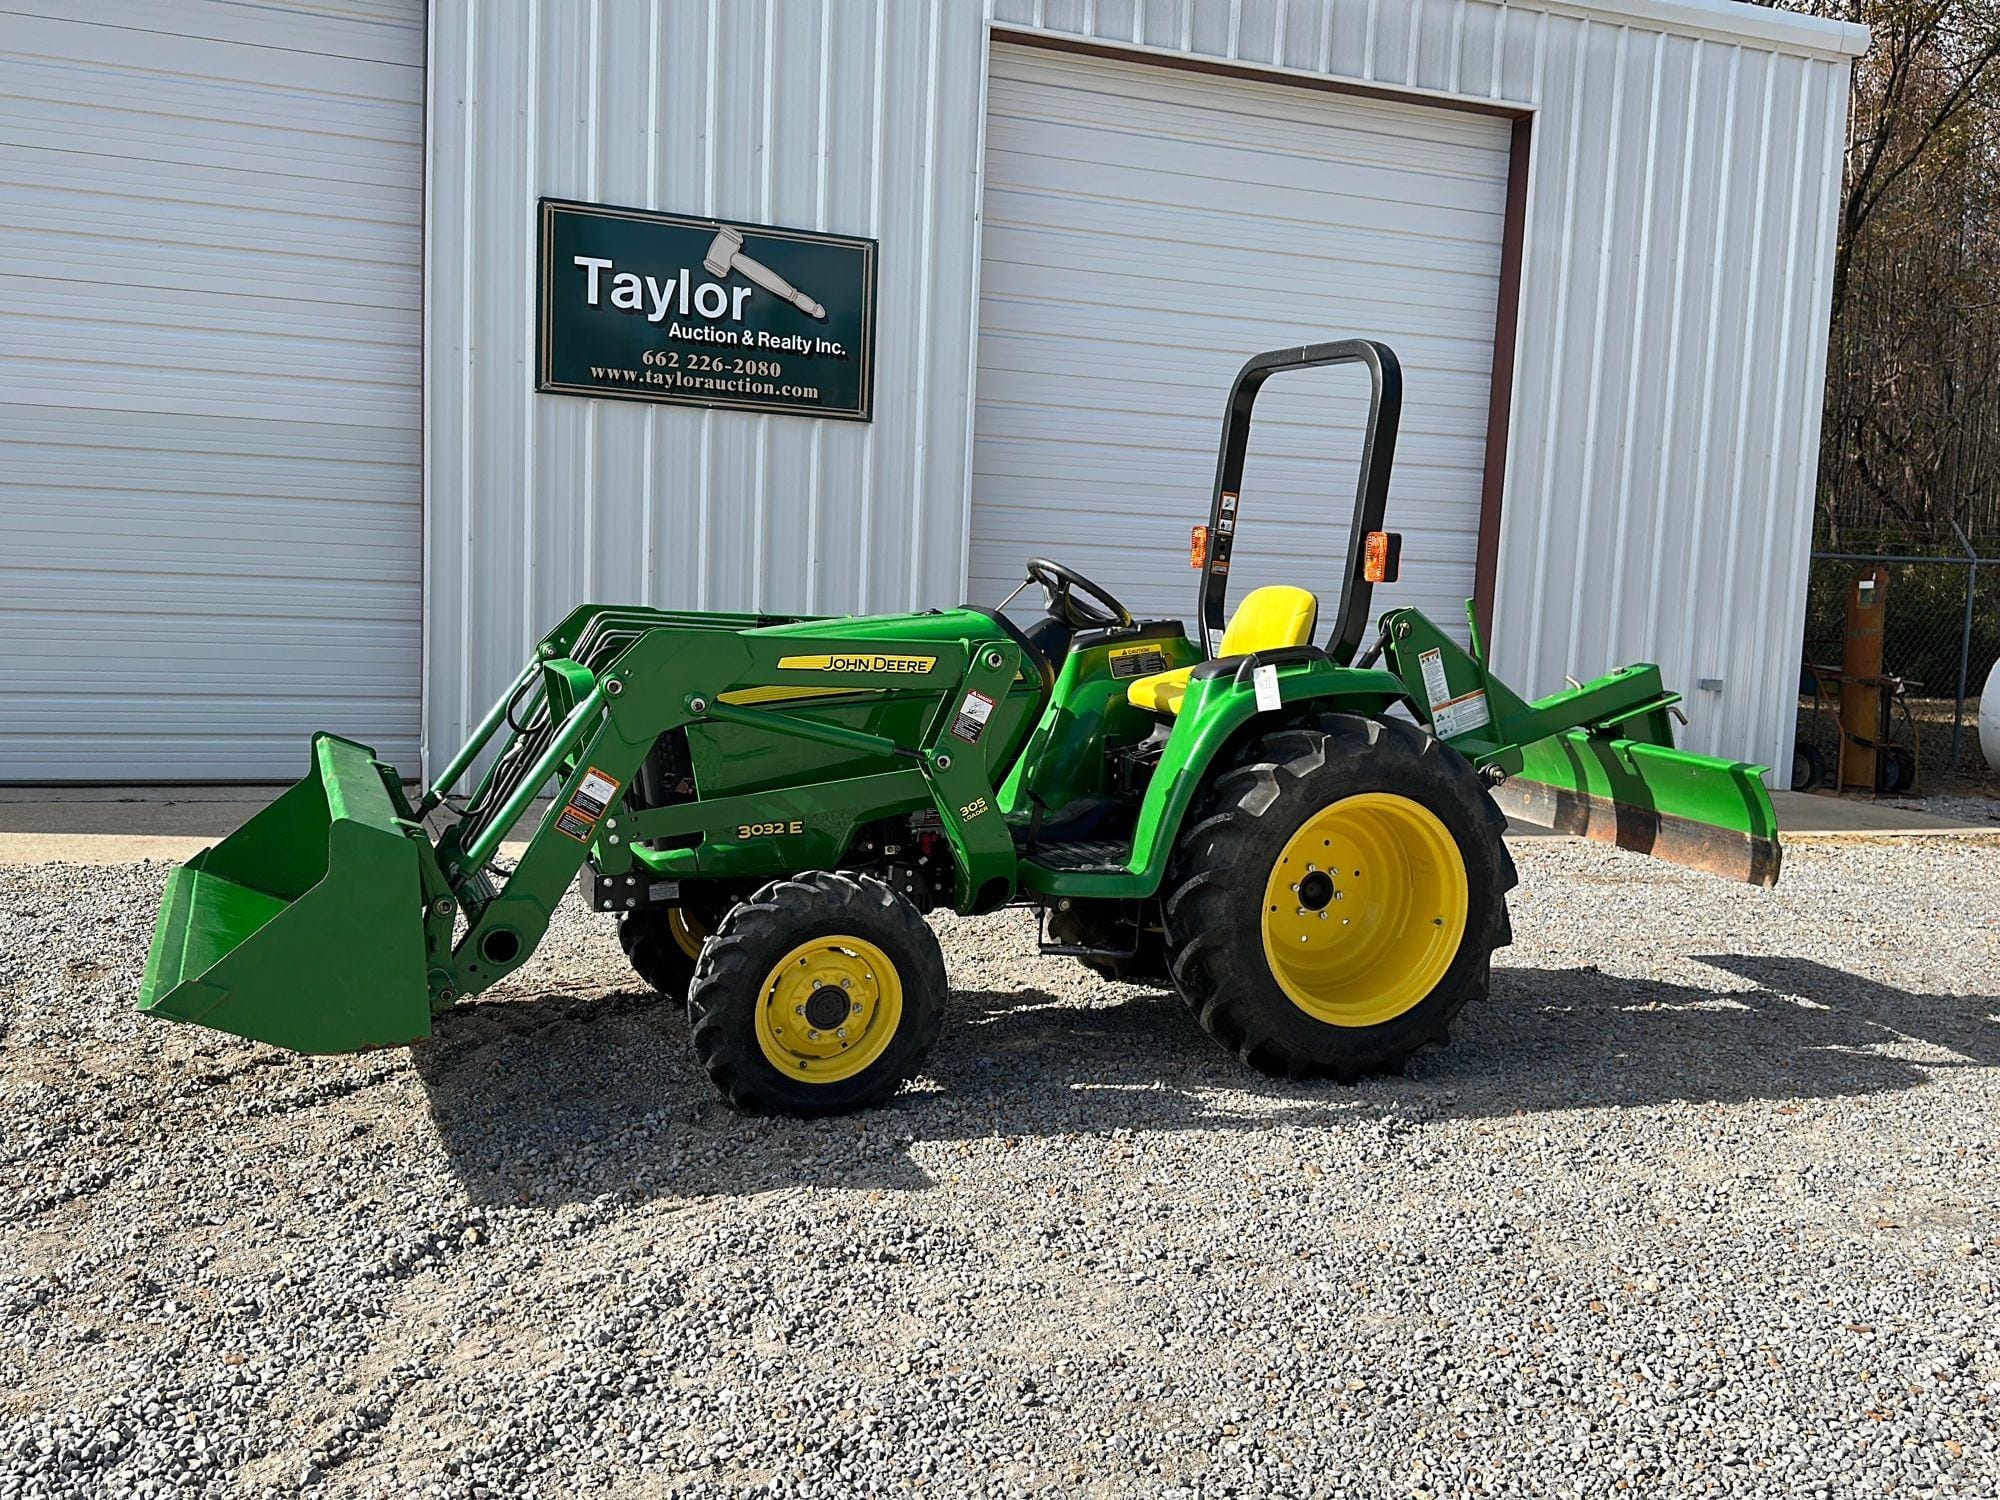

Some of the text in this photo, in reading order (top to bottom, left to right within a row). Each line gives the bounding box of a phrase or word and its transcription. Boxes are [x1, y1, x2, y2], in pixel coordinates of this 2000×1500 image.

[574, 256, 752, 322] Taylor
[668, 322, 846, 355] Auction & Realty Inc.
[642, 349, 782, 378] 662 226-2080
[590, 366, 819, 399] www.taylorauction.com
[824, 655, 928, 672] JOHN DEERE
[960, 797, 986, 817] 305
[963, 805, 989, 823] LOADER
[738, 820, 803, 840] 3032 E
